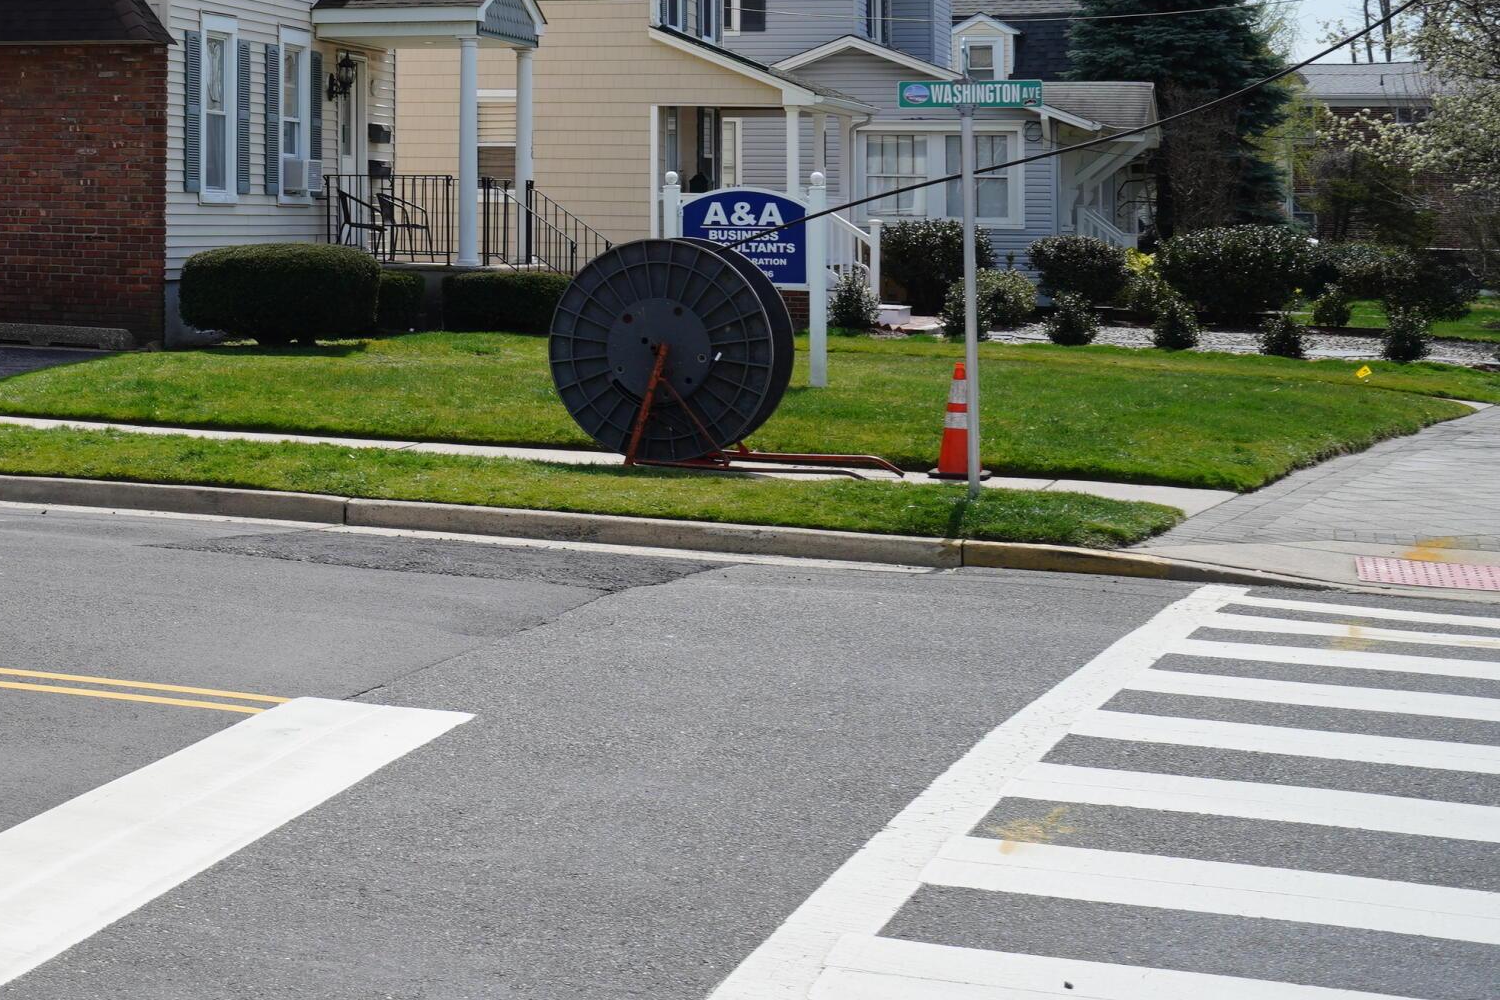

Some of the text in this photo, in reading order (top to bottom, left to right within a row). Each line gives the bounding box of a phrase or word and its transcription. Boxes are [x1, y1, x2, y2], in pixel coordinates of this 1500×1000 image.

[930, 84, 1041, 104] WASHINGTON AVE
[702, 201, 785, 226] A&A
